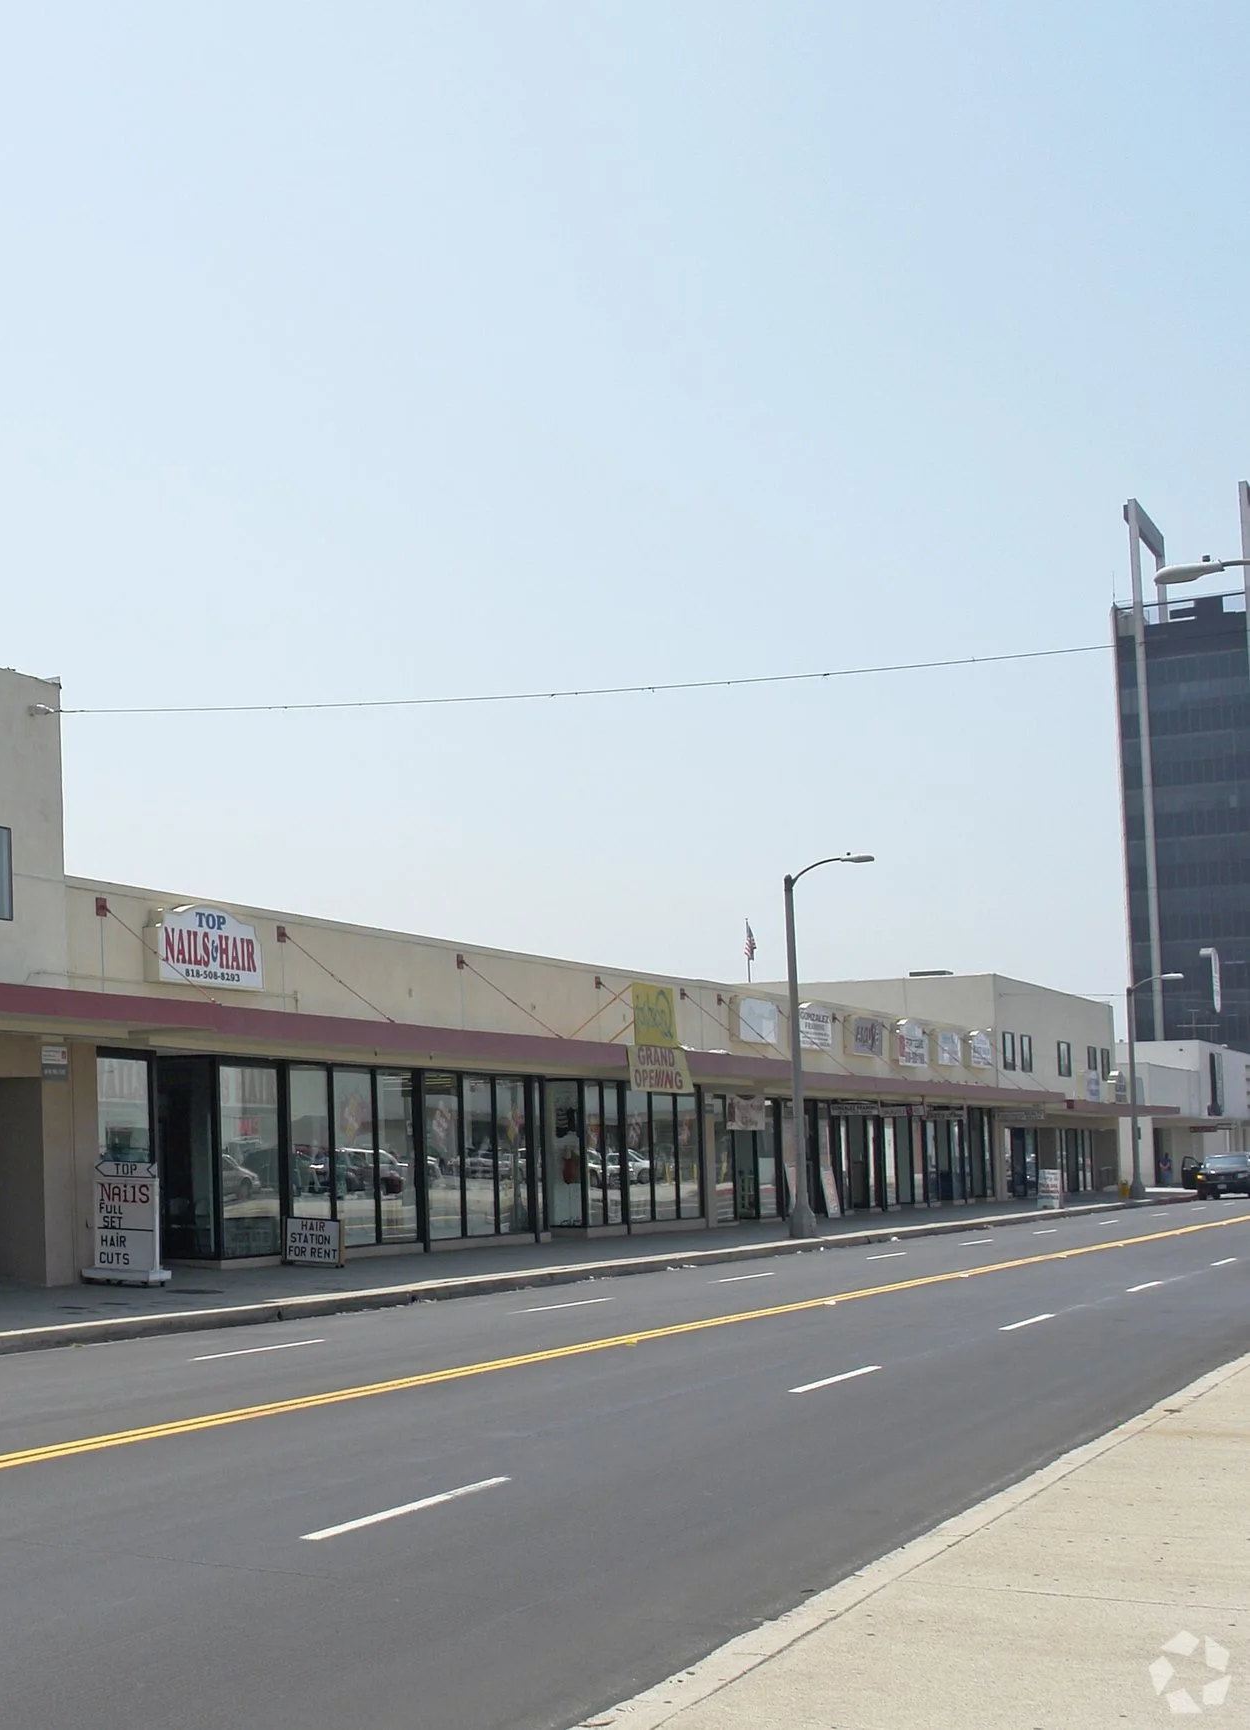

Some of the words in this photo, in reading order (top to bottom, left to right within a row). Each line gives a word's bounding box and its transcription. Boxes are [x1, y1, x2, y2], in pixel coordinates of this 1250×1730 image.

[195, 912, 226, 930] TOP
[164, 927, 210, 968] NAILS
[218, 934, 257, 973] HAIR
[185, 968, 240, 982] 818-508-8293
[637, 1047, 675, 1067] GRAND
[634, 1069, 684, 1090] OPENING
[114, 1163, 137, 1175] TOP
[99, 1202, 123, 1215] FULL
[103, 1216, 123, 1228] SET
[301, 1221, 326, 1232] HAIR
[290, 1232, 331, 1245] STATION
[99, 1252, 130, 1265] CUTS
[288, 1245, 307, 1257] FOR
[310, 1247, 338, 1259] RENT
